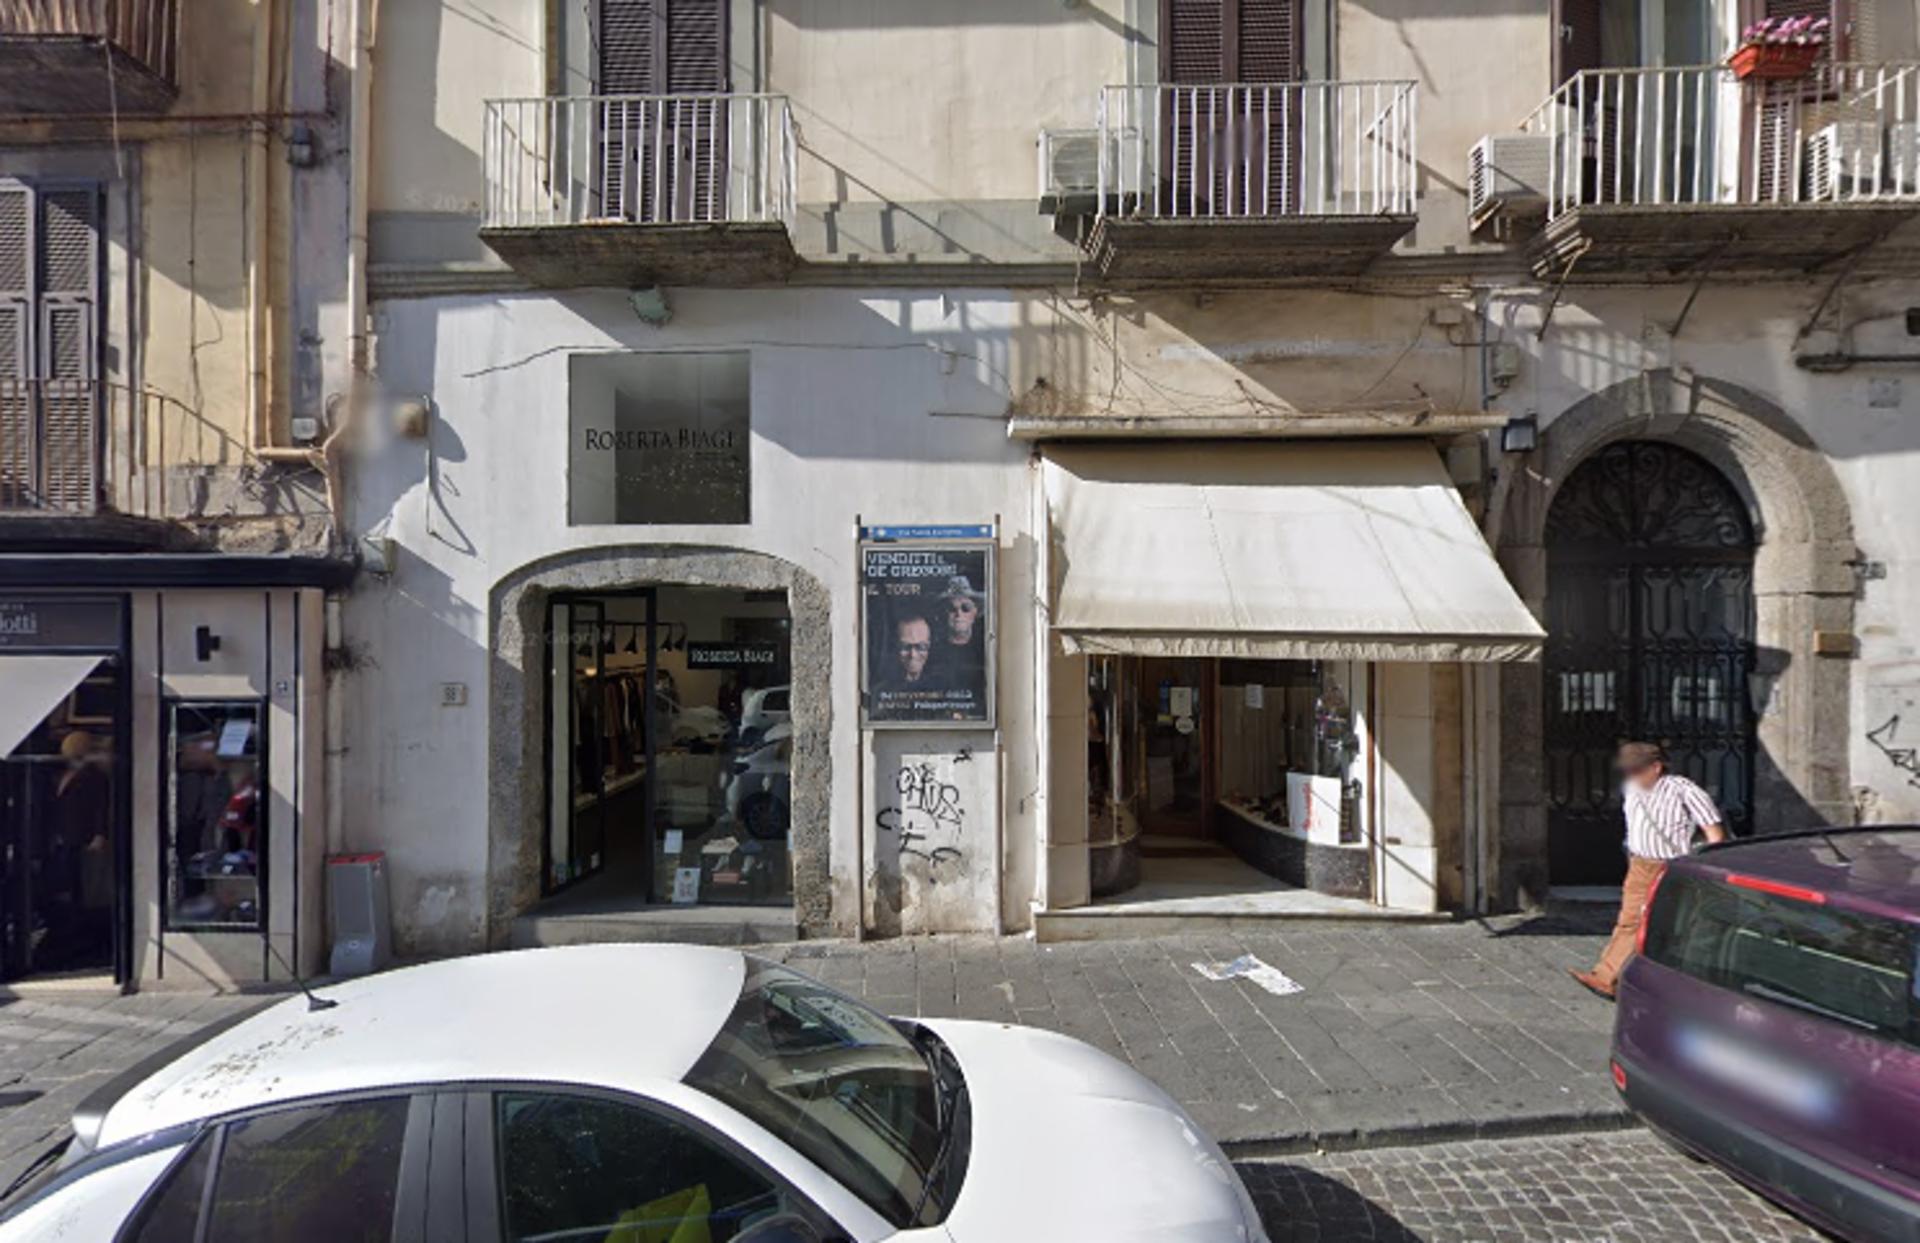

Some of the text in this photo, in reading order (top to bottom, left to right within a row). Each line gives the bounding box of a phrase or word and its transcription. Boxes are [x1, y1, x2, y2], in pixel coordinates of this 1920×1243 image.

[585, 427, 733, 450] ROBERTA BIAGI
[867, 565, 887, 577] DE
[692, 650, 741, 662] ROBERTA
